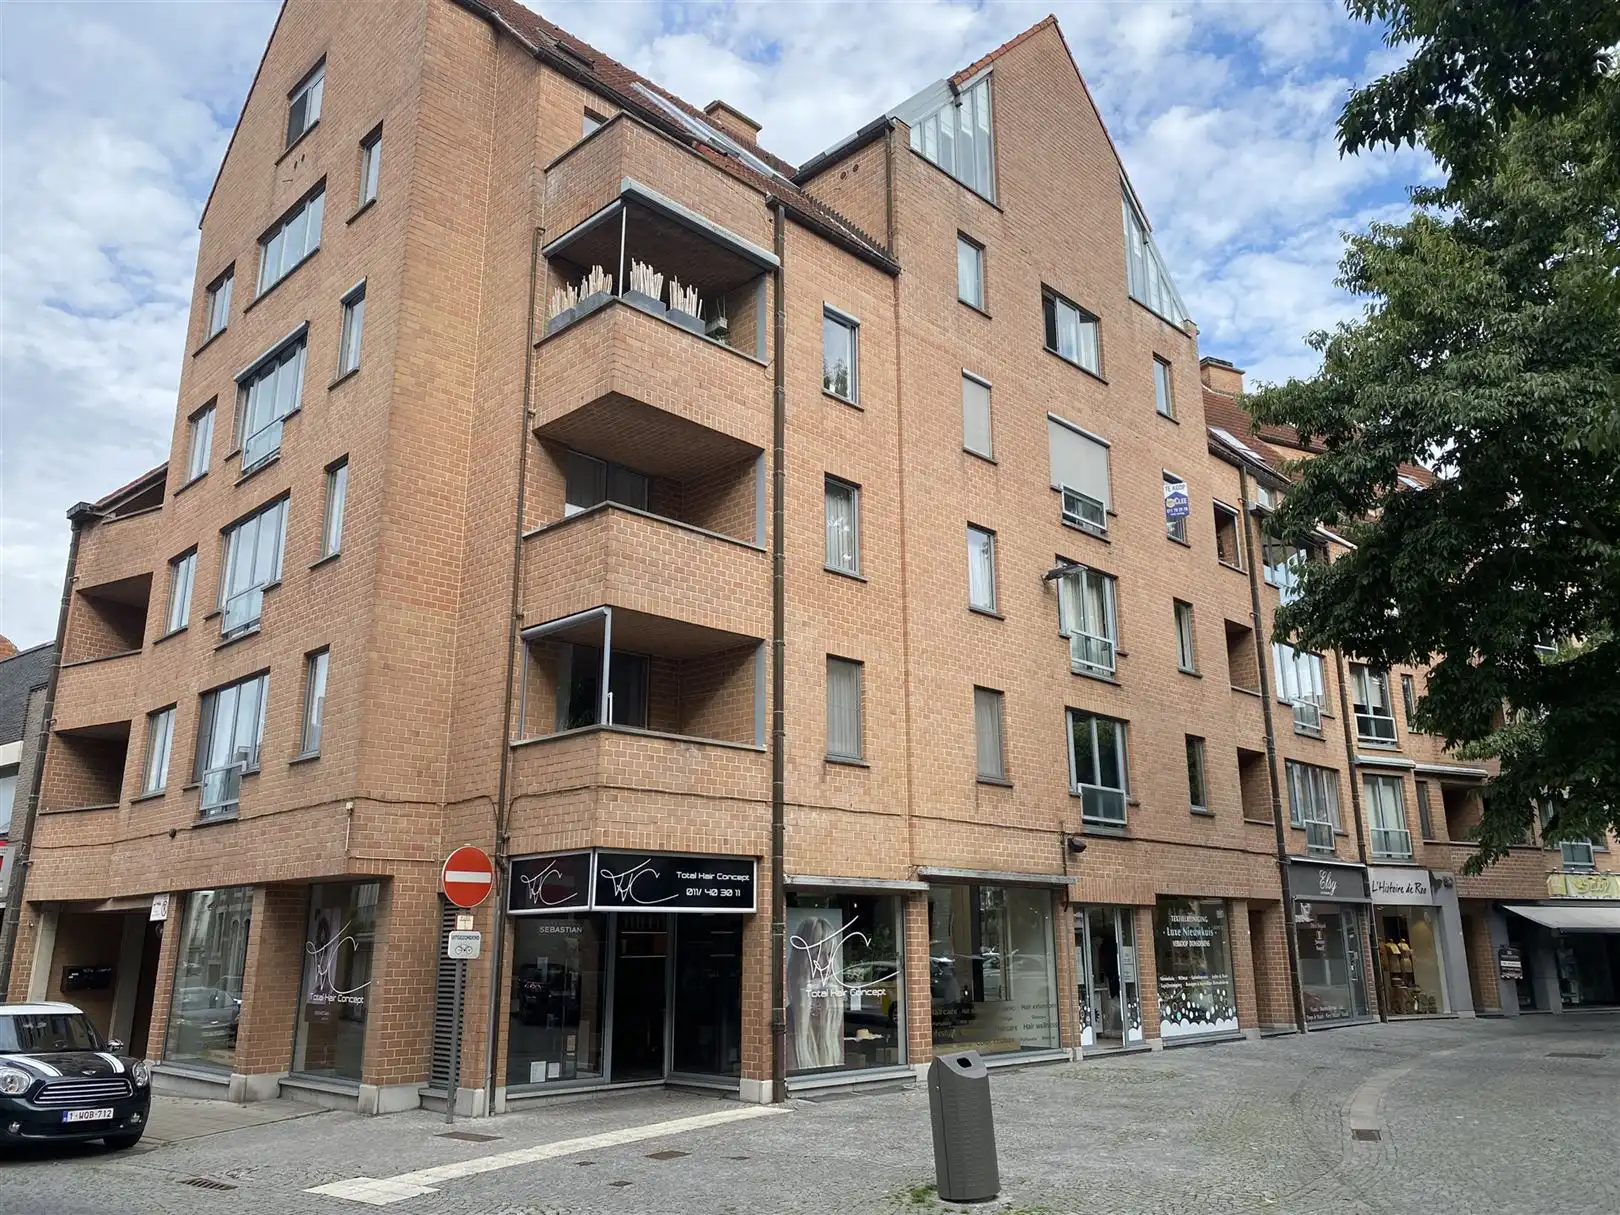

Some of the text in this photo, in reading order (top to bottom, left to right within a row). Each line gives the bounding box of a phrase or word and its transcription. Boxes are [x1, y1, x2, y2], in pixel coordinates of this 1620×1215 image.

[676, 871, 750, 882] Total Hair Concept
[1319, 869, 1337, 896] Elsy
[1405, 882, 1413, 893] de
[705, 888, 718, 896] 40
[720, 888, 733, 896] 30
[735, 888, 741, 896] 11
[1166, 926, 1181, 936] Luxe
[805, 988, 887, 998] Total Hair Concept
[324, 993, 336, 1002] Hair
[337, 994, 364, 1005] Concept
[70, 1109, 112, 1120] 1-WOB-712
